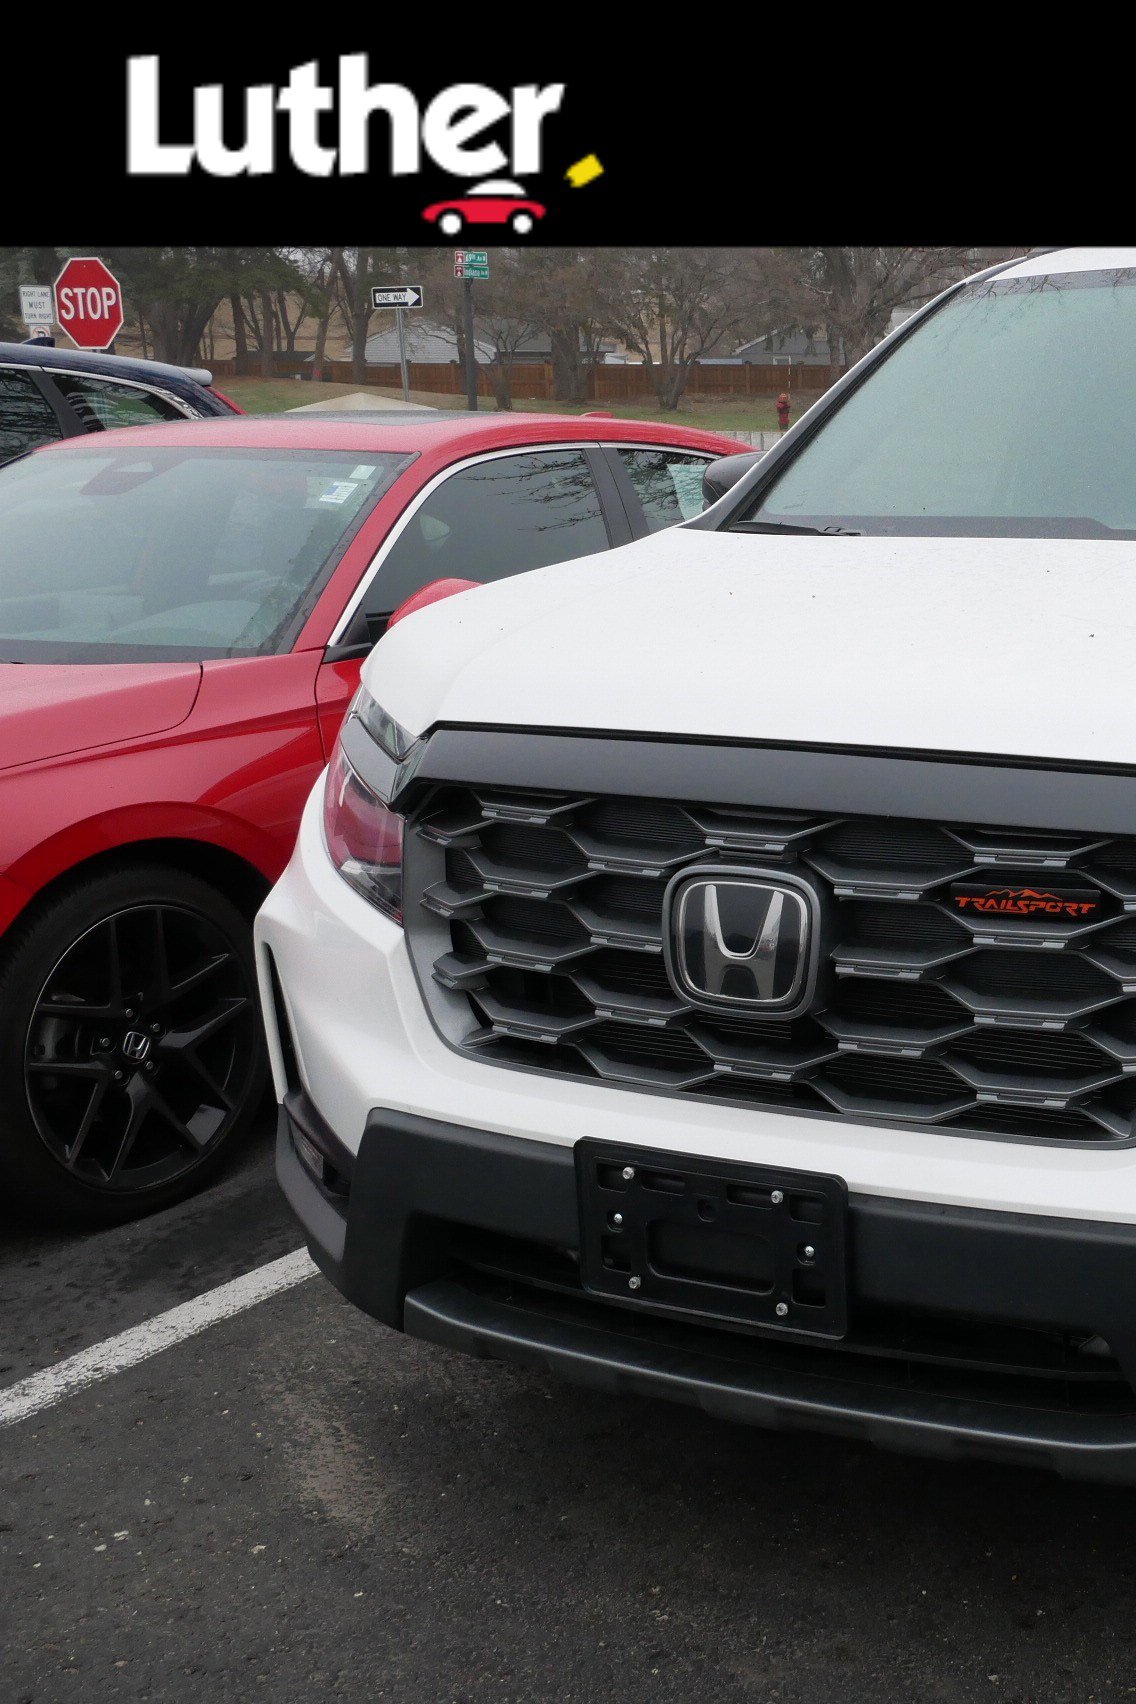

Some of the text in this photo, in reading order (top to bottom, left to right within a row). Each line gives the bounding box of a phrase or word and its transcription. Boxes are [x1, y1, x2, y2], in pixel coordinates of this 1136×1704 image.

[22, 290, 50, 298] RIGHT LANE
[377, 292, 407, 302] ONE WAY
[28, 301, 45, 309] MUST
[60, 286, 117, 320] STOP
[954, 896, 1096, 917] TRAILSPORT
